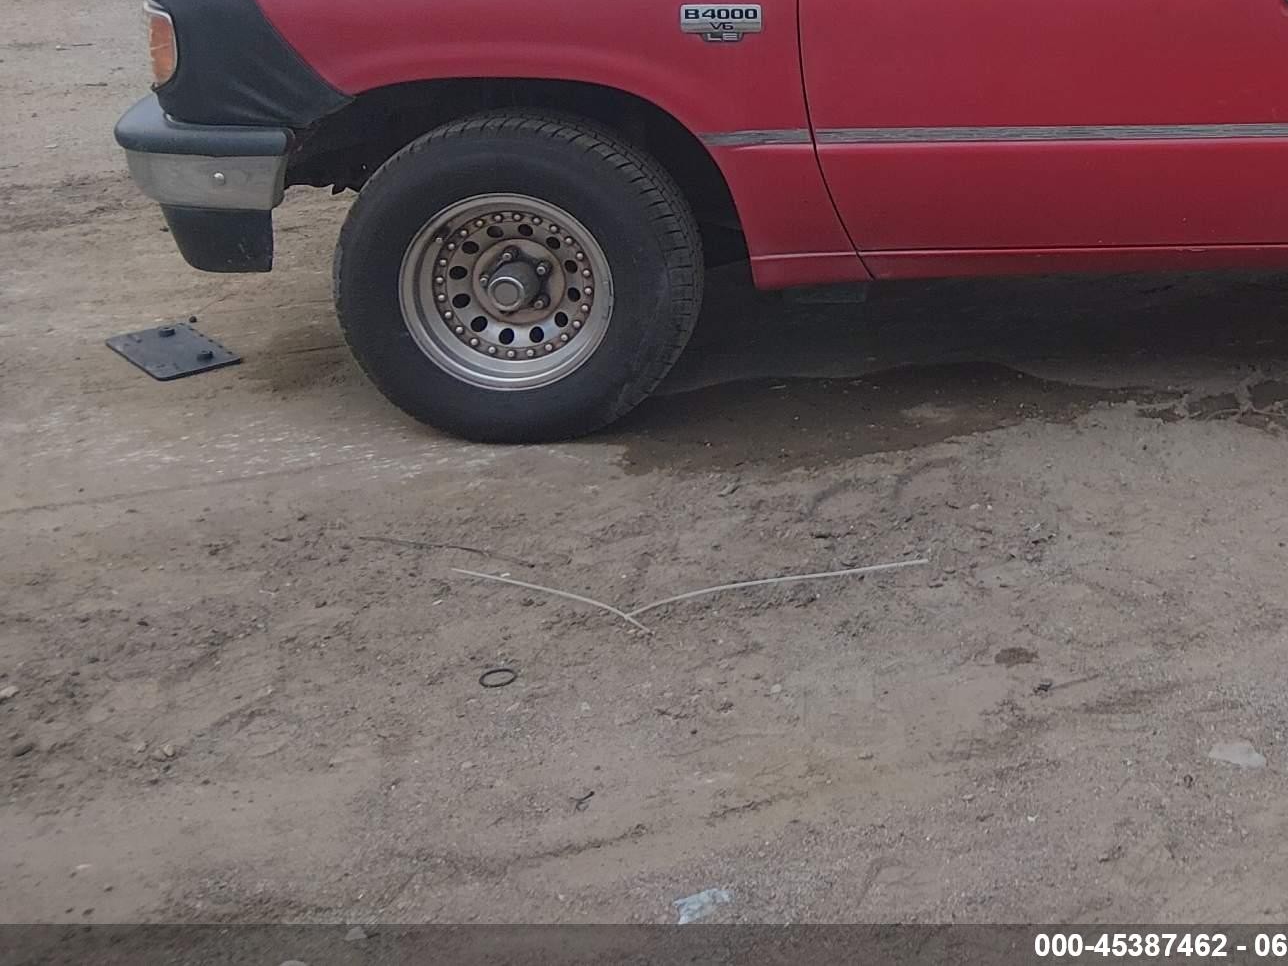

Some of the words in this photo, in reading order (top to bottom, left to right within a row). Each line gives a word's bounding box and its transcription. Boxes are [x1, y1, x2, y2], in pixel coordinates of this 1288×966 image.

[684, 8, 758, 20] B4000
[709, 21, 735, 31] V6
[707, 33, 739, 42] LE
